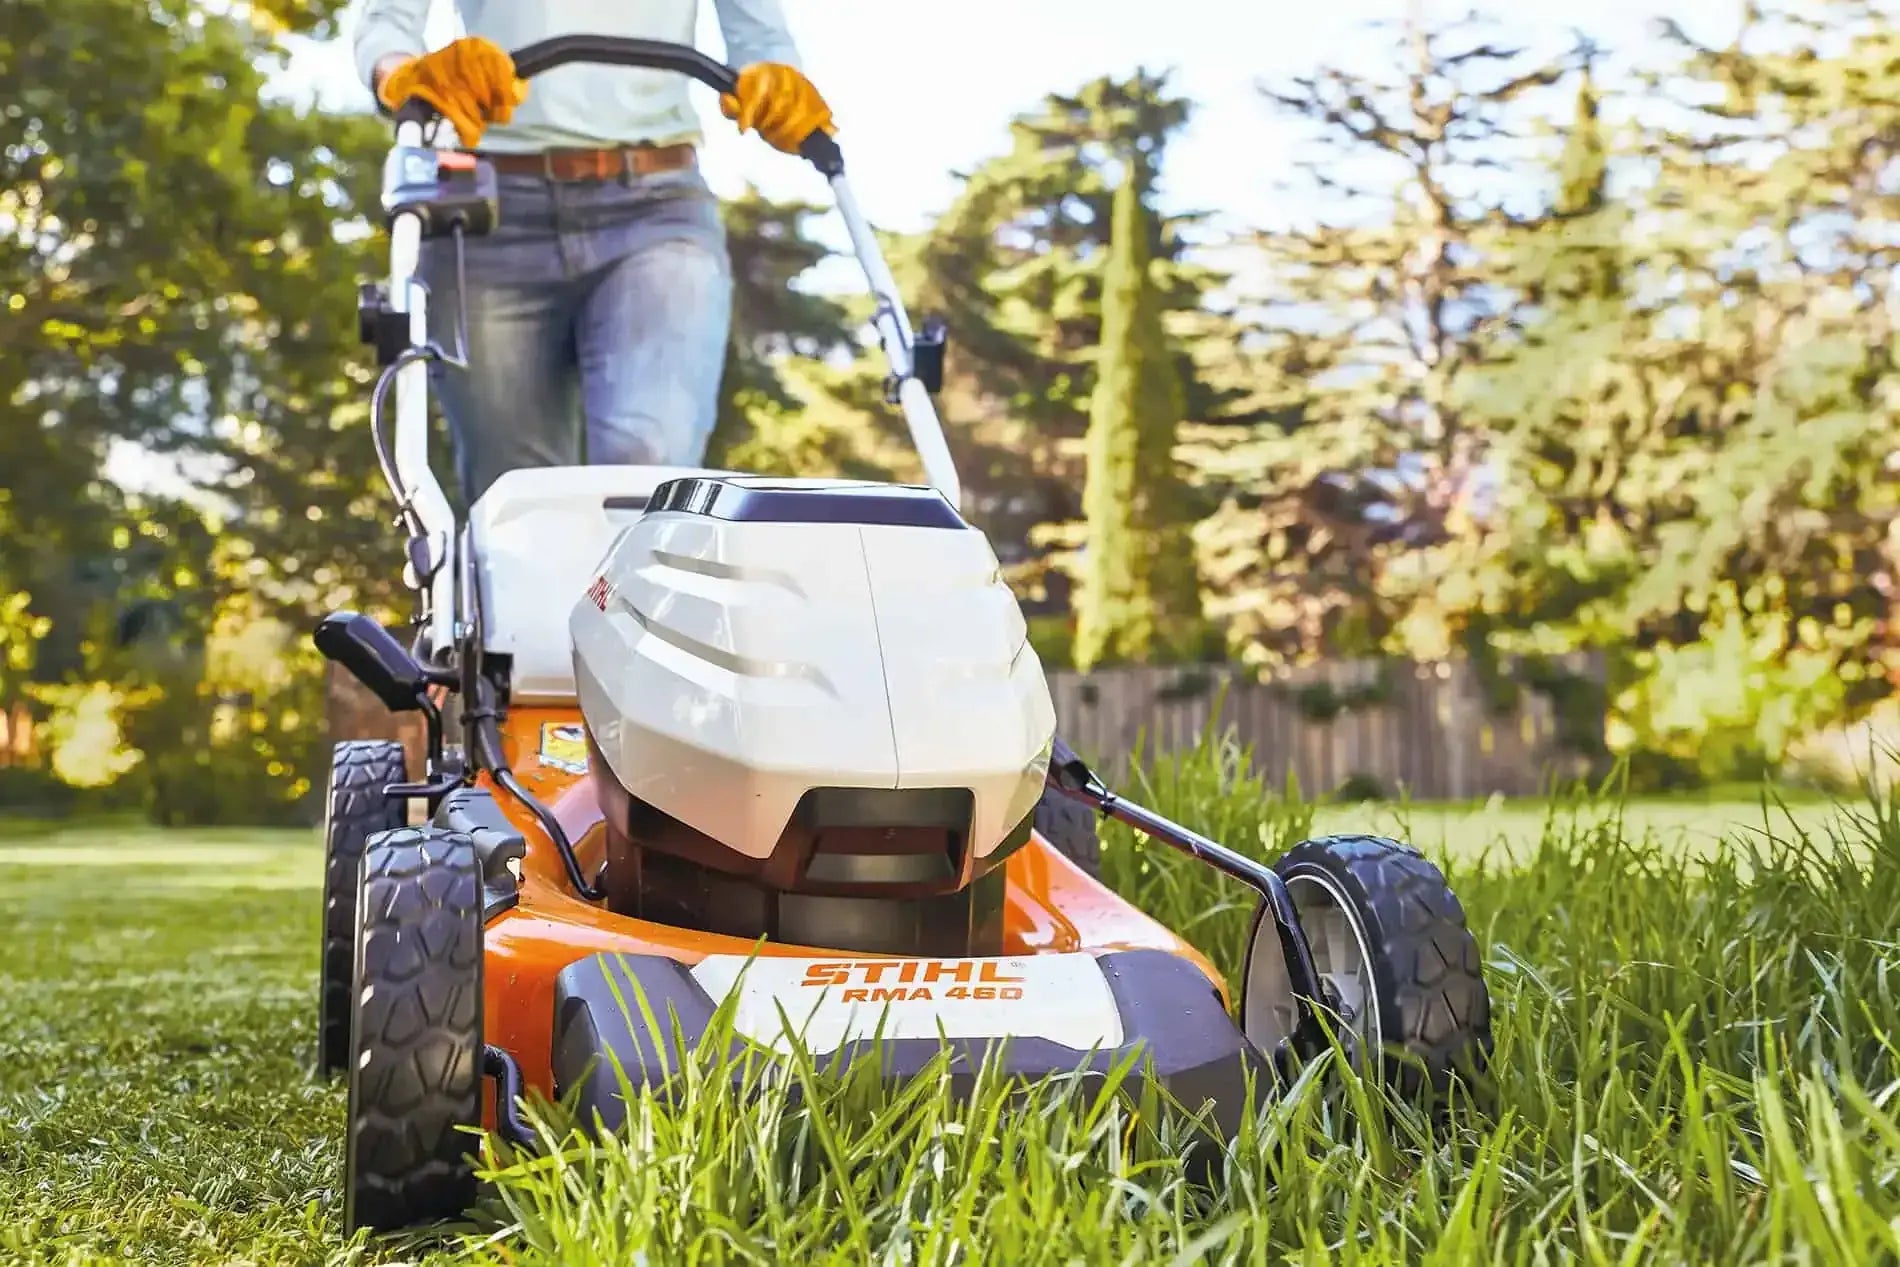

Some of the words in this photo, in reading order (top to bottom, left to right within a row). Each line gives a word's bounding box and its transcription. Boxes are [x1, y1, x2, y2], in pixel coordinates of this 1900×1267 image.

[801, 961, 1025, 987] STIHL
[841, 987, 932, 1003] RMA
[945, 987, 1024, 1001] 460
